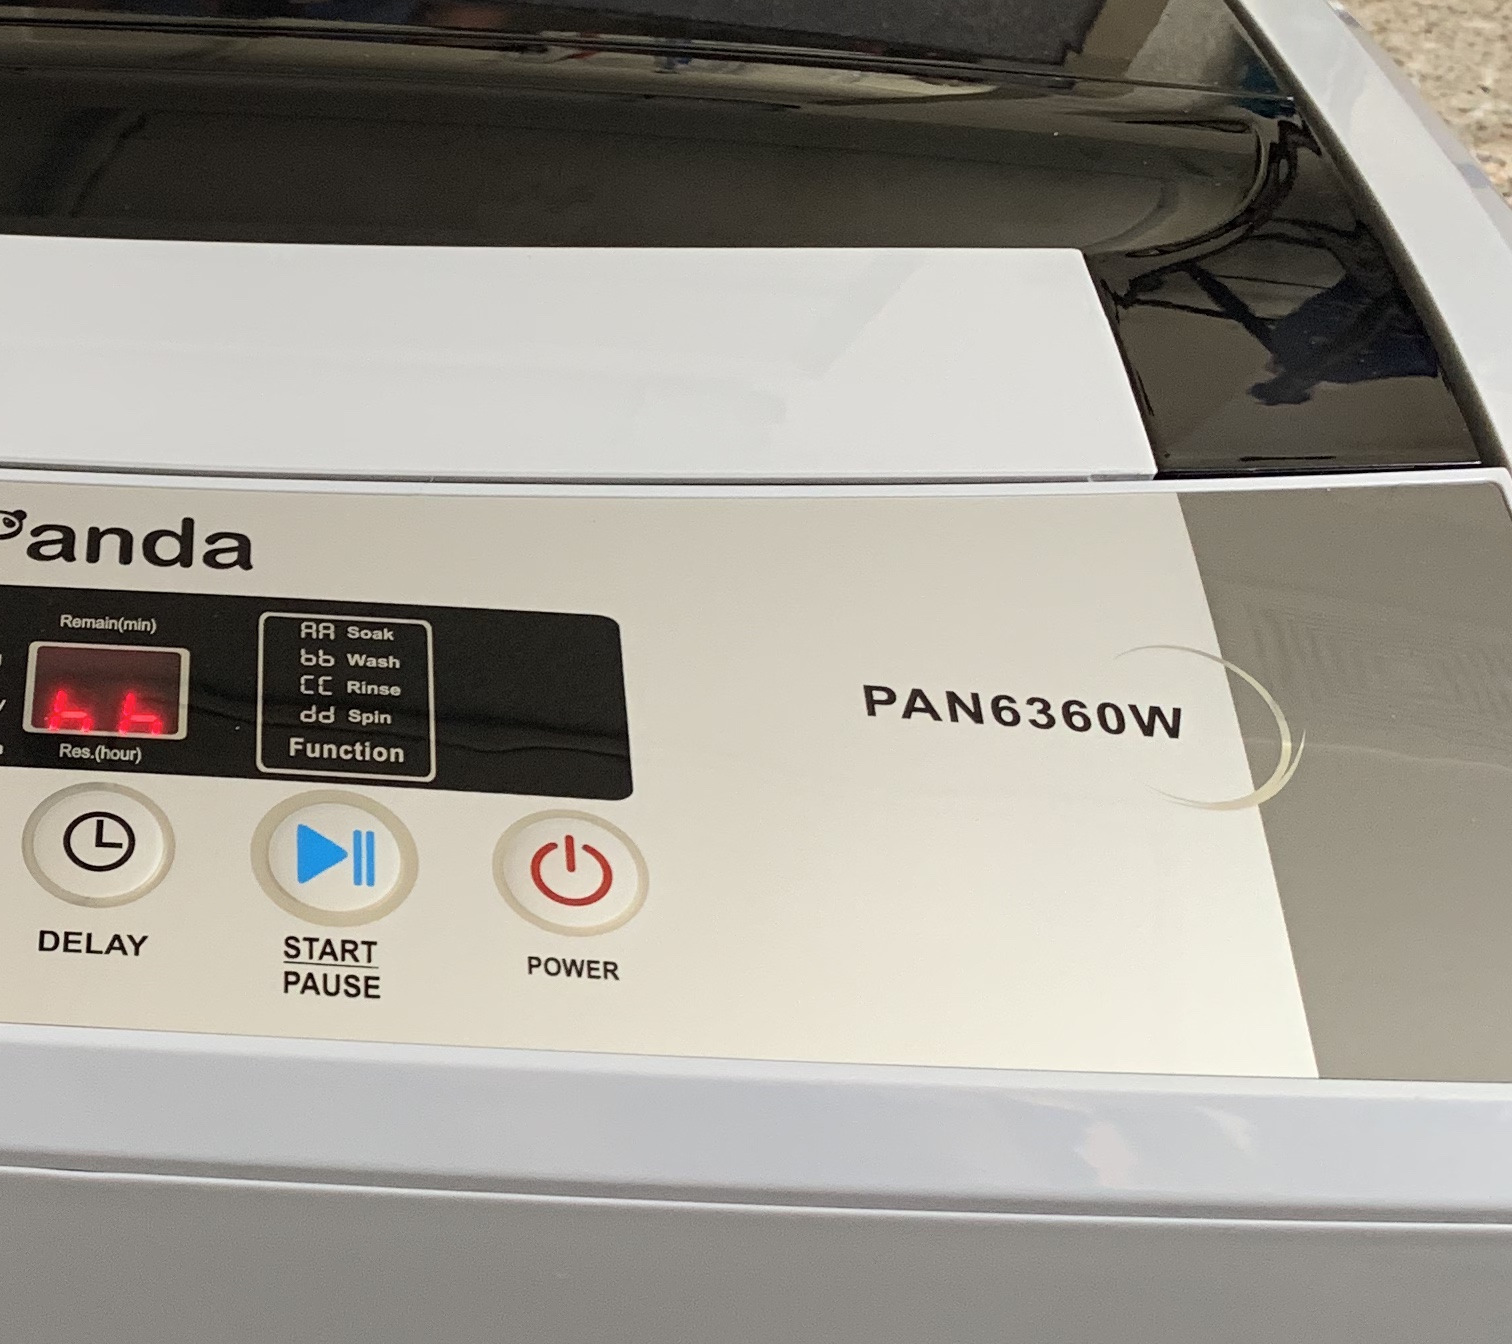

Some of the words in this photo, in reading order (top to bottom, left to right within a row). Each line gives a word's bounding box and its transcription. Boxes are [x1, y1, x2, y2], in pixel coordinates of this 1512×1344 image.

[59, 614, 157, 635] Remain(min)
[346, 625, 395, 641] Soak
[346, 653, 401, 669] Wash
[346, 680, 402, 697] Rinse
[347, 708, 392, 726] Spin
[863, 684, 1182, 739] PAN6360W
[59, 742, 142, 765] Res.(hour)
[289, 737, 405, 763] Function
[38, 929, 149, 957] DELAY
[283, 935, 378, 962] START
[527, 955, 620, 981] POWER
[283, 970, 381, 999] PAUSE
